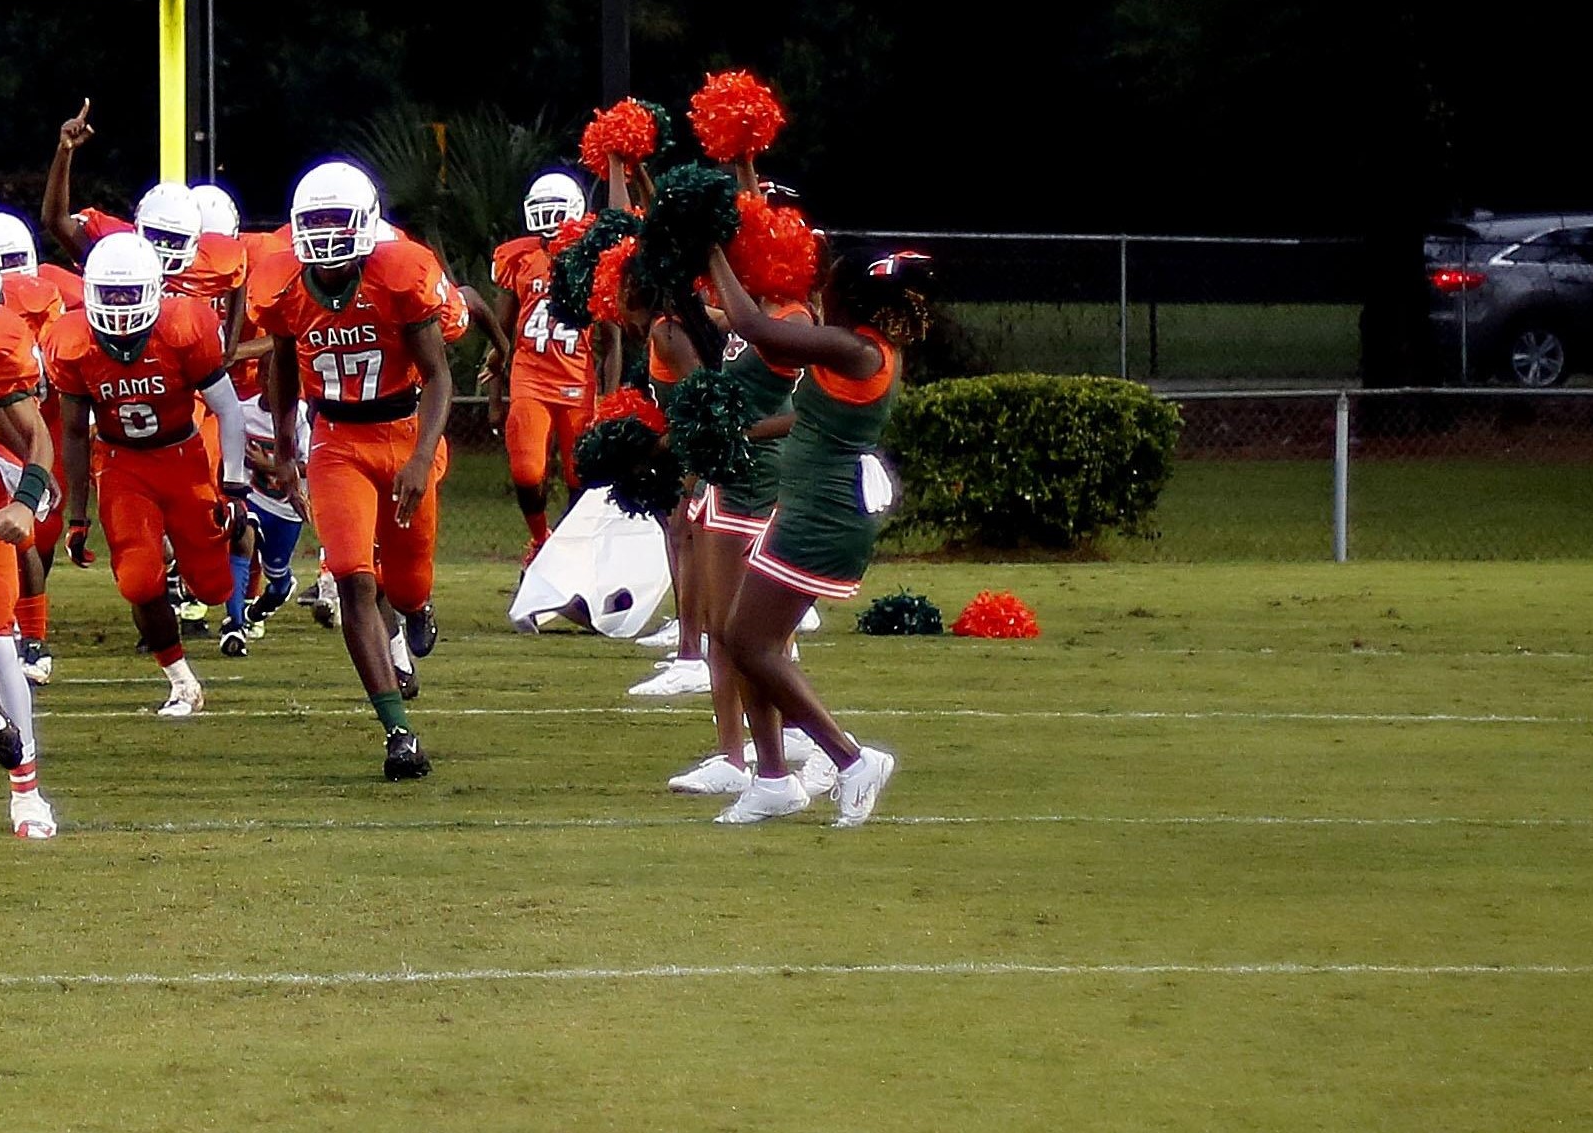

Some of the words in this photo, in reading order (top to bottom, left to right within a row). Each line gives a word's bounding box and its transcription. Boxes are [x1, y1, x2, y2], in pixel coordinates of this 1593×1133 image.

[308, 324, 378, 348] RAMS
[100, 375, 167, 401] RAMS
[312, 349, 383, 402] 17
